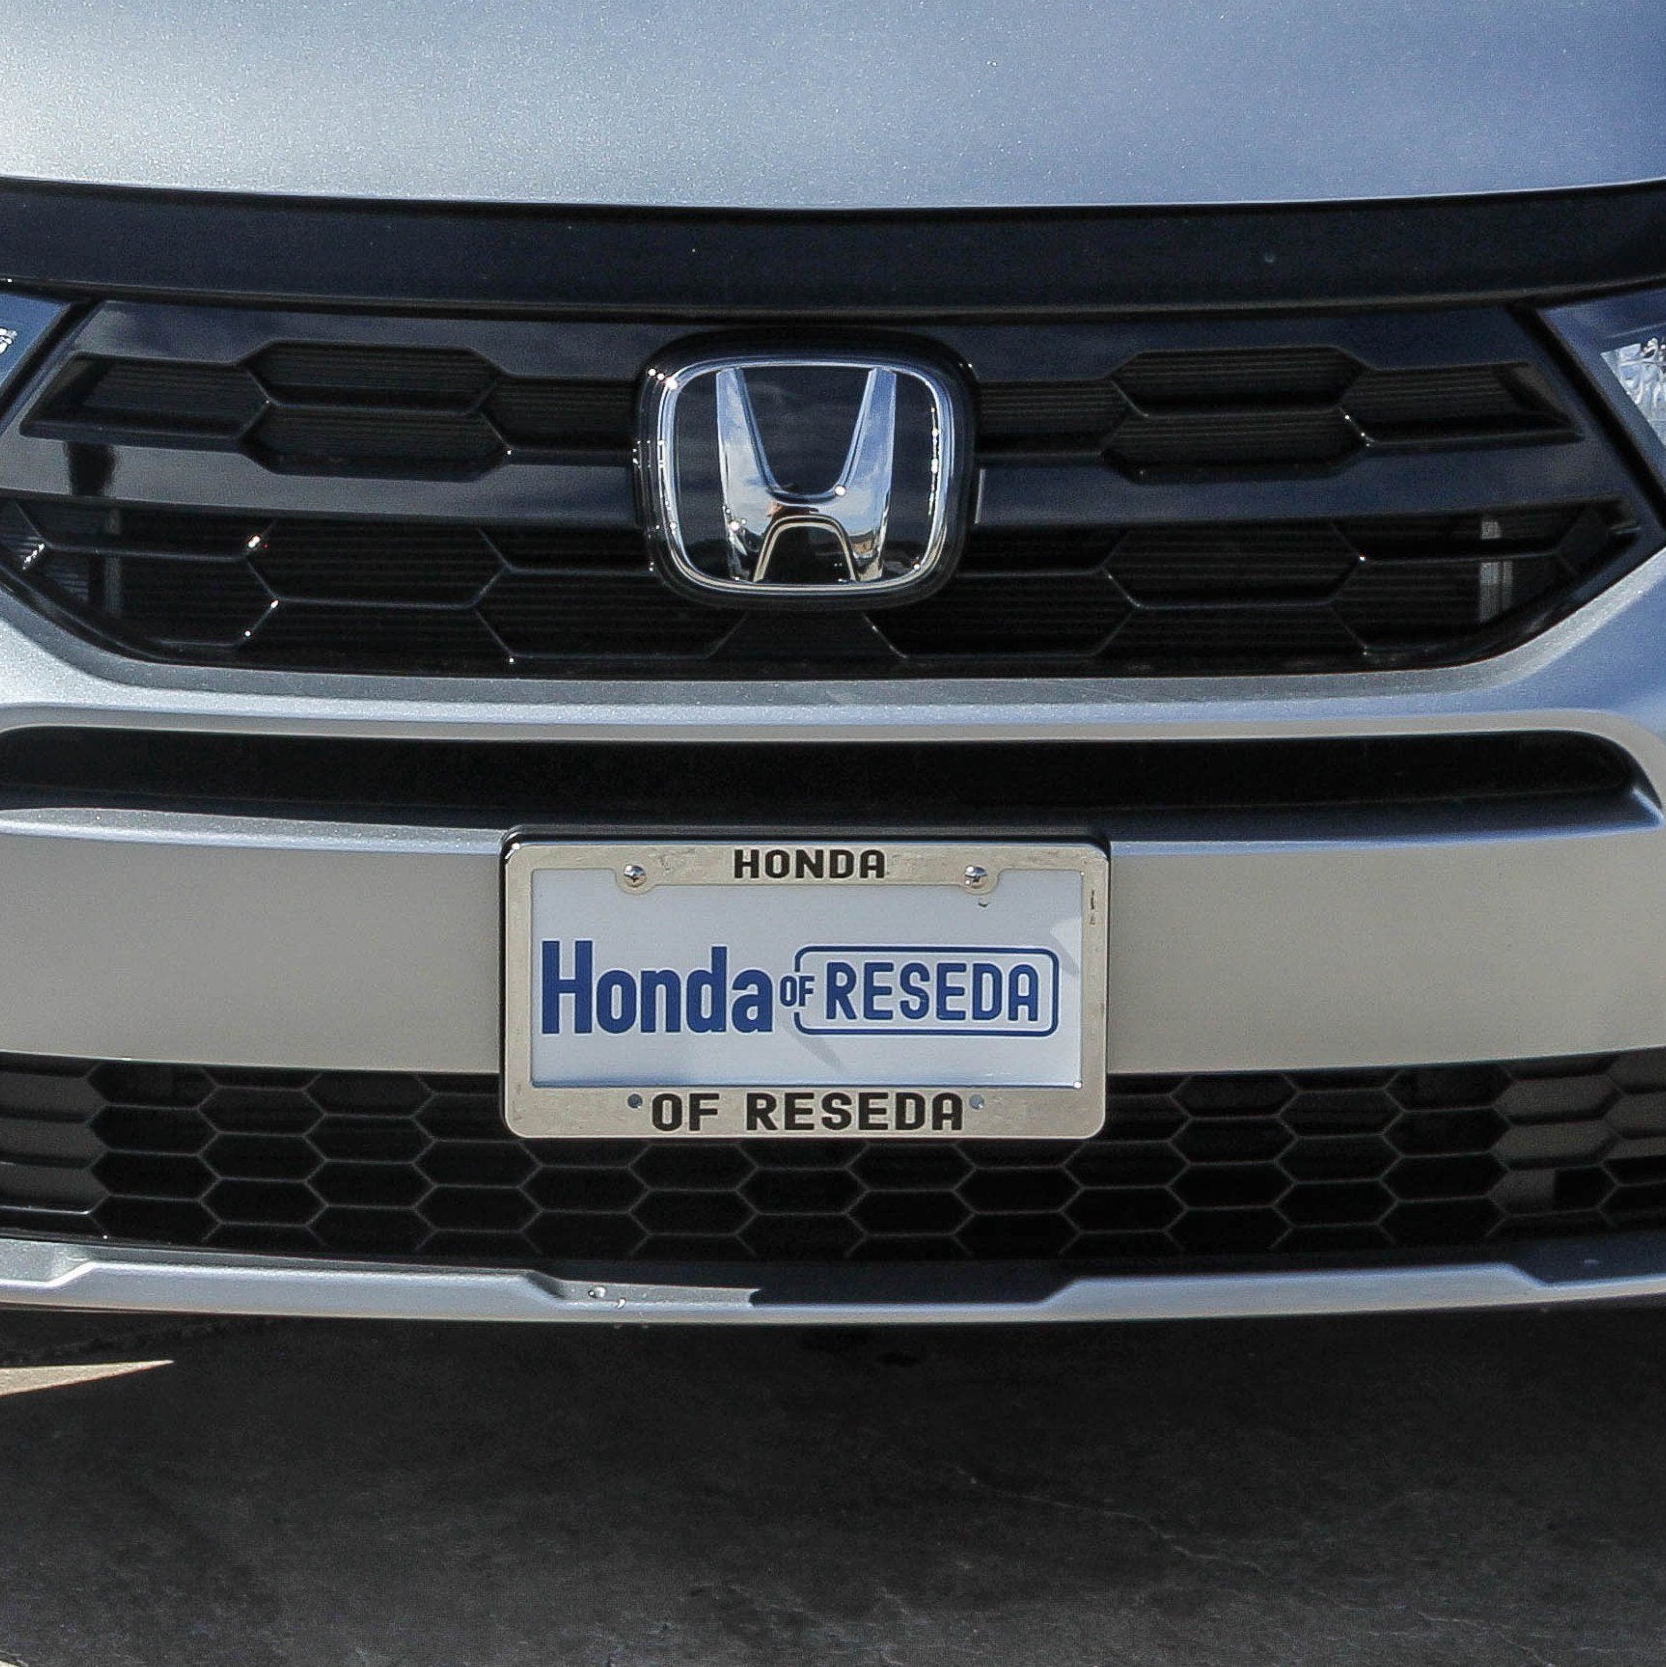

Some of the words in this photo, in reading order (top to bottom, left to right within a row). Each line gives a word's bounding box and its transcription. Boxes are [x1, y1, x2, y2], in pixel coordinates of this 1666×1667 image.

[733, 848, 886, 880] HONDA
[541, 939, 774, 1035] Honda
[779, 974, 816, 1008] OF
[825, 961, 1039, 1022] RESEDA
[651, 1092, 721, 1132] OF
[745, 1091, 964, 1132] RESEDA
